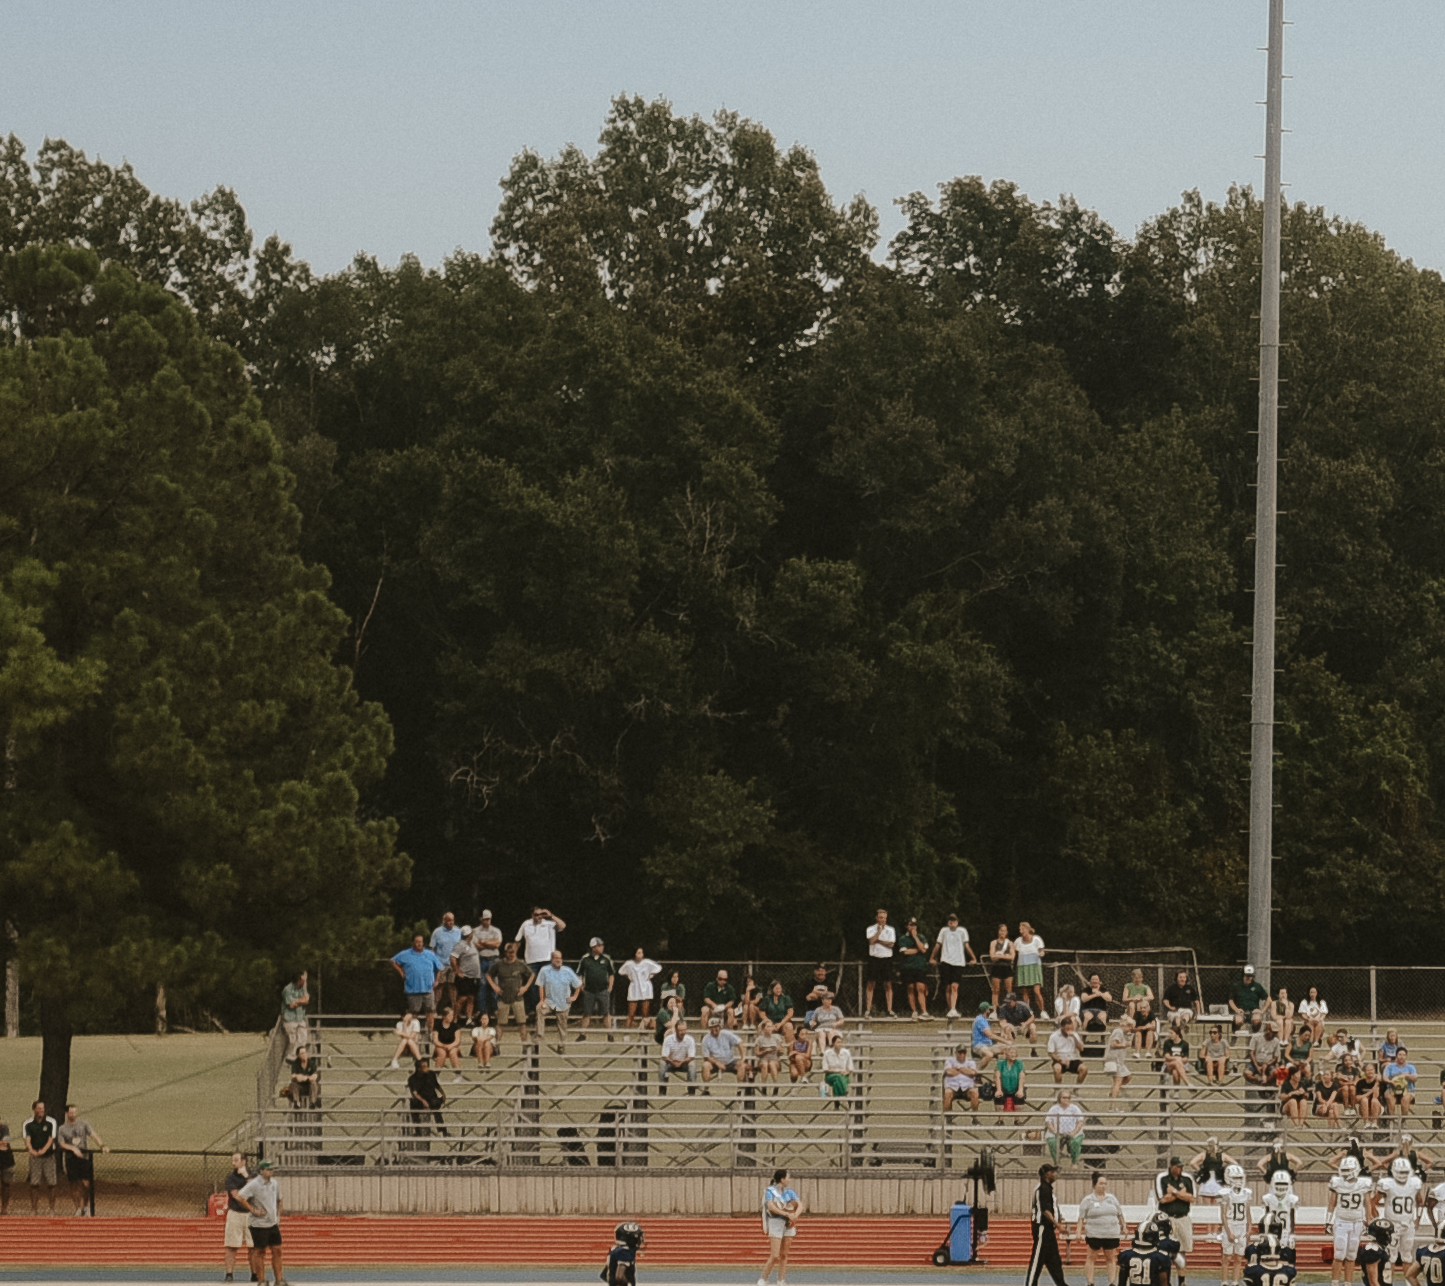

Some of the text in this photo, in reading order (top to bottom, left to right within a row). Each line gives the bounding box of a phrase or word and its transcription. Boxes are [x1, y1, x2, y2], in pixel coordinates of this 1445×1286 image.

[1340, 1192, 1362, 1210] 59
[1392, 1196, 1414, 1215] 60
[1232, 1202, 1246, 1221] 19
[1129, 1257, 1152, 1286] 21
[1420, 1255, 1444, 1284] 70
